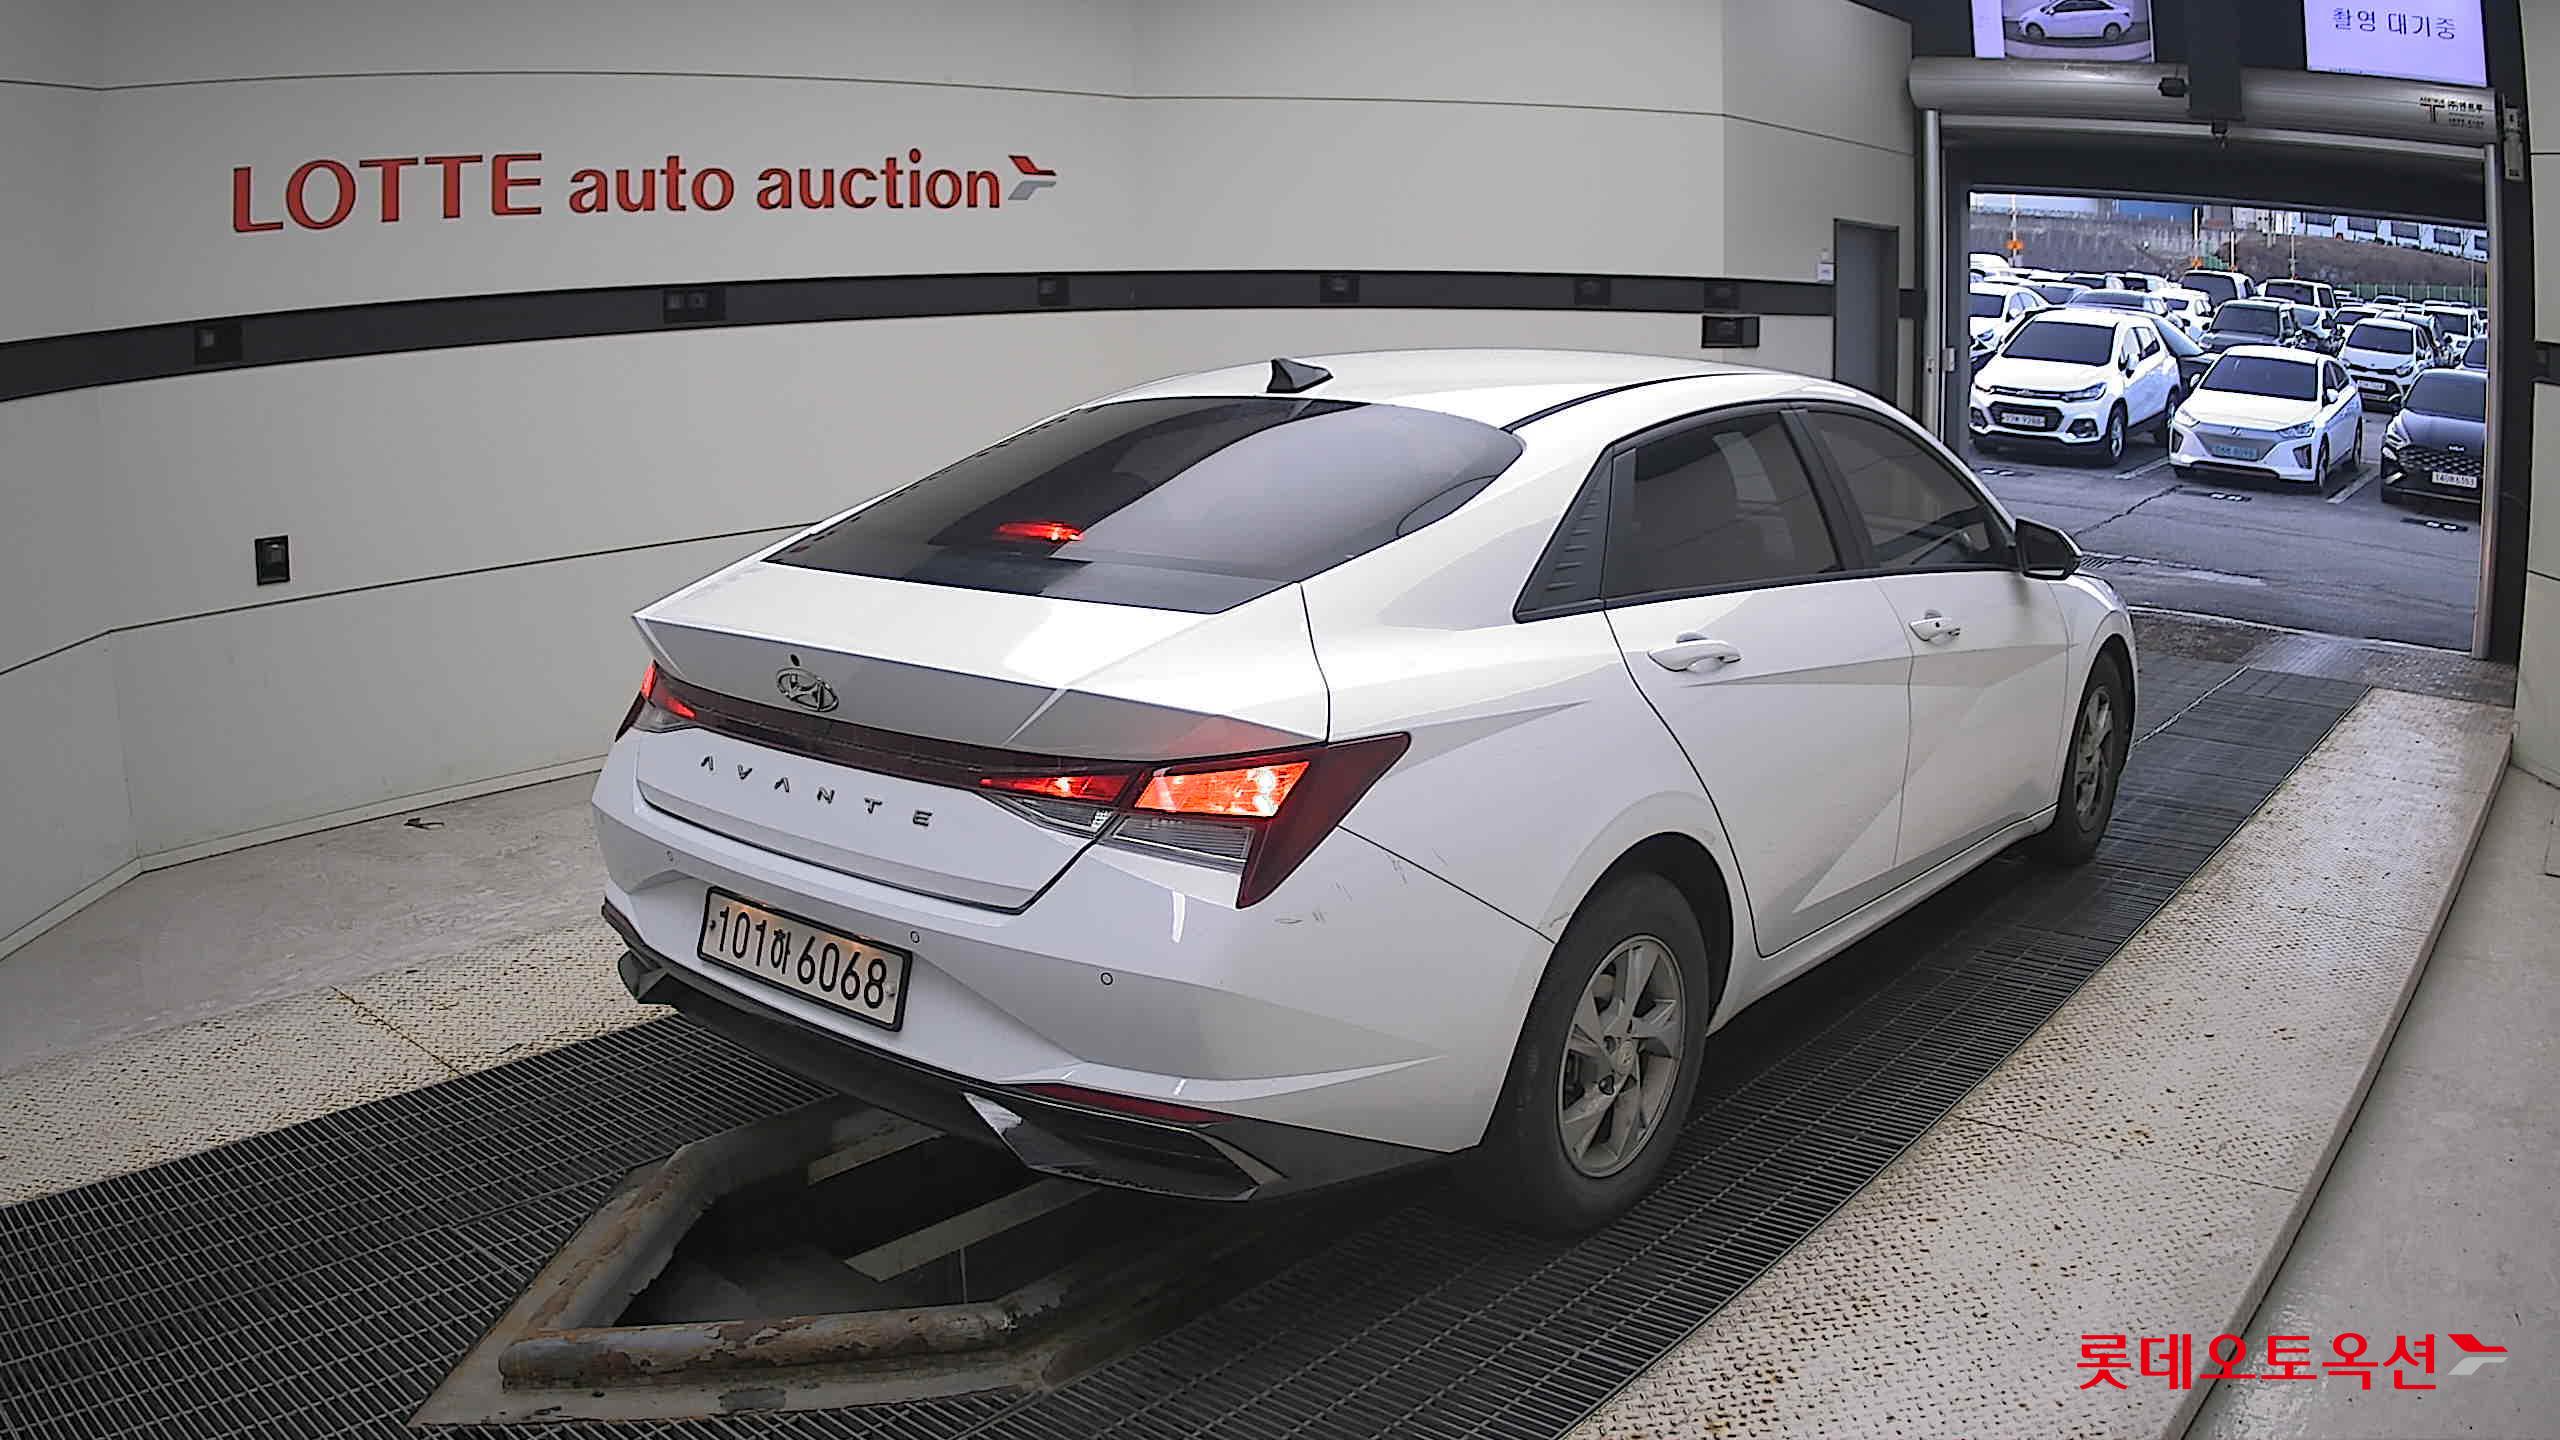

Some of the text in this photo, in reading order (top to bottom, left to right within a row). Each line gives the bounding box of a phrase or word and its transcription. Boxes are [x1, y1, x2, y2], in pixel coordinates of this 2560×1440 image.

[2333, 7, 2457, 41] 촬영 대기중
[233, 150, 1002, 232] LOTTE auto auction
[700, 755, 935, 828] AVANTE
